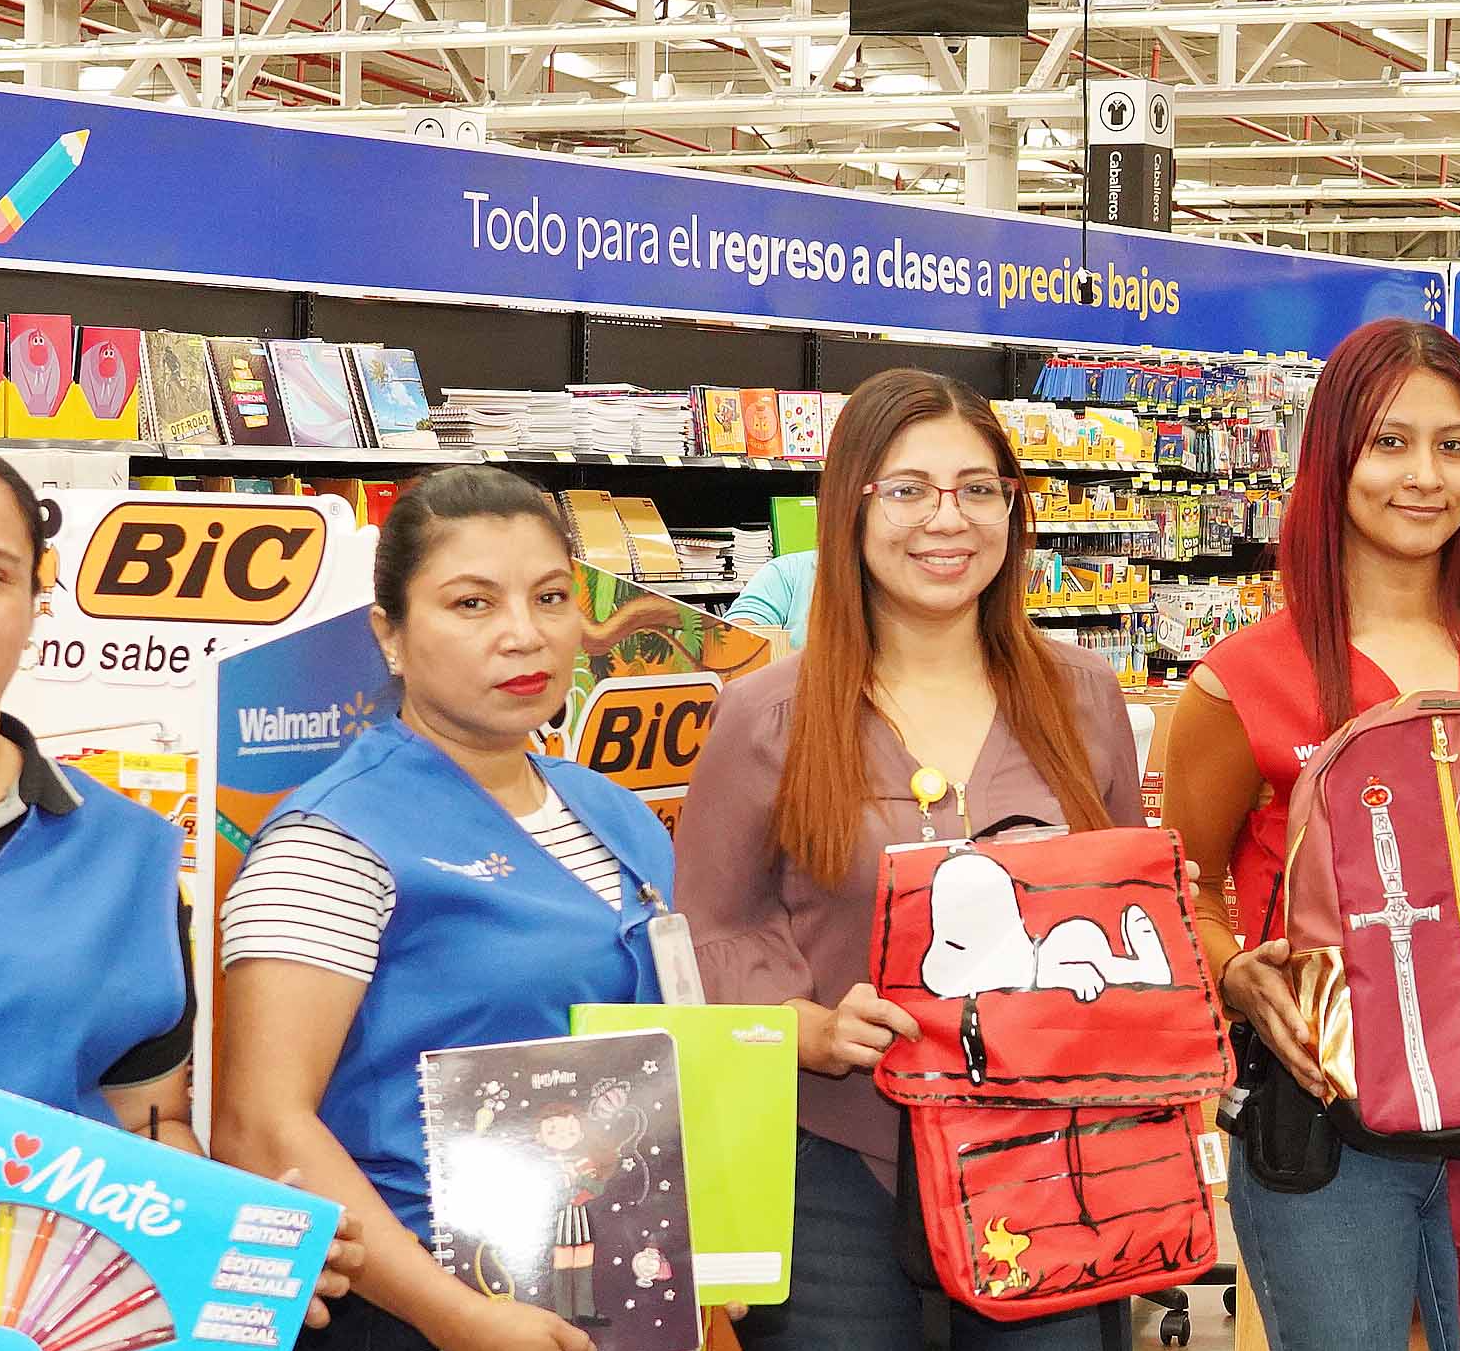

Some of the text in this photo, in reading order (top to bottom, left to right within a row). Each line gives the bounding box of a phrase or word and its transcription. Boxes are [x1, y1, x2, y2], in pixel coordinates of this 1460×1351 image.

[1108, 150, 1123, 221] Caballeros
[463, 190, 566, 257] Todo
[576, 213, 659, 271] para
[668, 215, 700, 268] el
[709, 229, 846, 286] regreso
[853, 251, 870, 285] a
[876, 246, 971, 296] clases
[976, 263, 993, 298] a
[1108, 263, 1180, 321] bajos
[169, 416, 210, 437] OFF-ROAD
[40, 635, 190, 672] no sabe
[239, 704, 340, 743] Walmart
[20, 1146, 182, 1237] Mate
